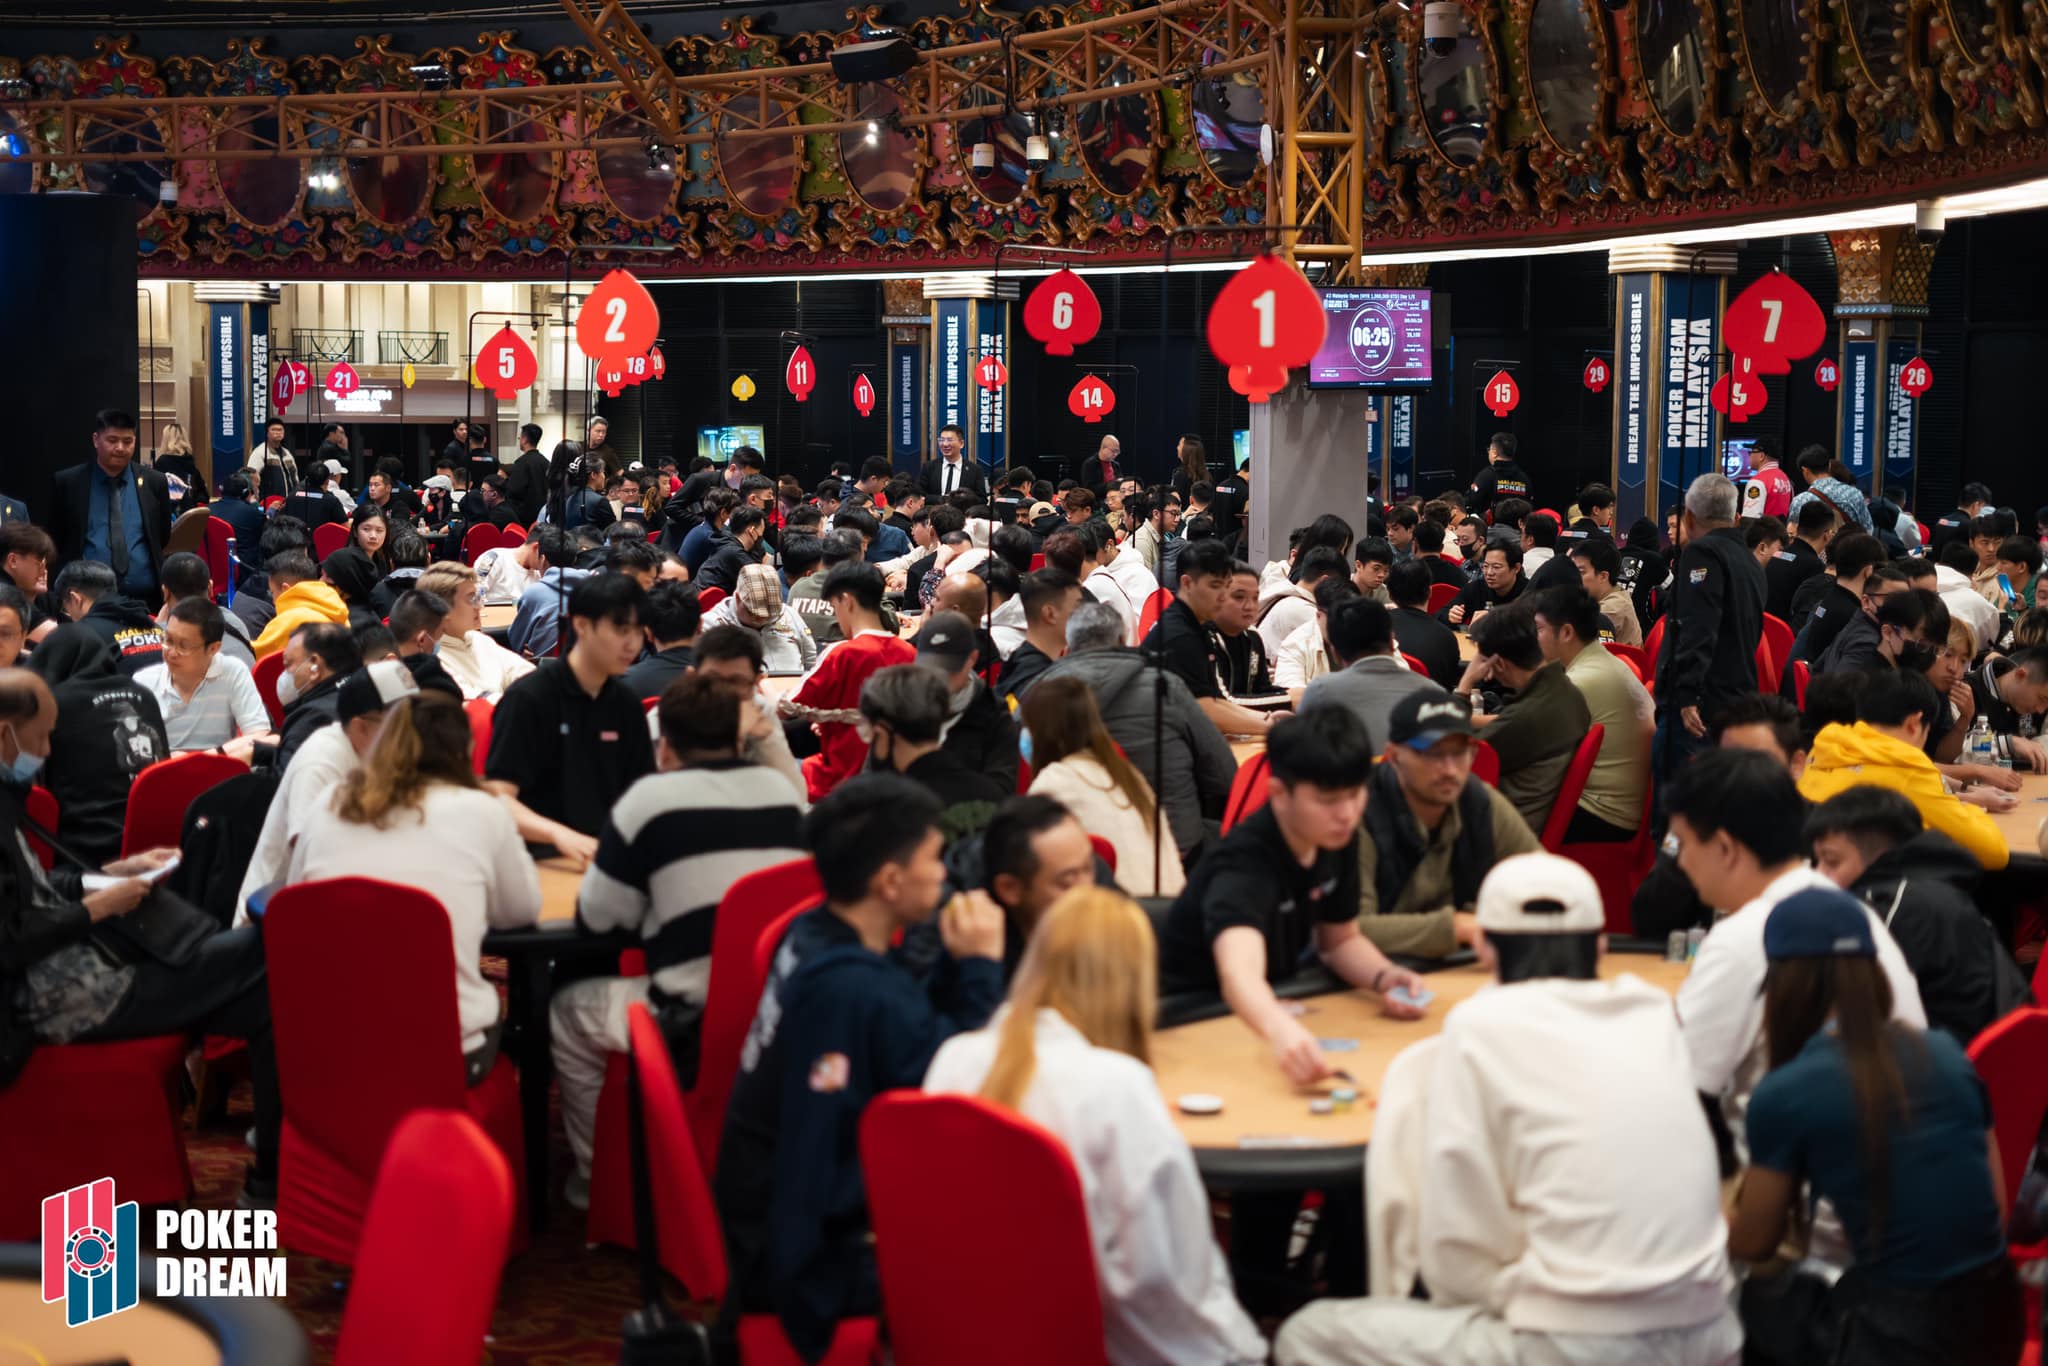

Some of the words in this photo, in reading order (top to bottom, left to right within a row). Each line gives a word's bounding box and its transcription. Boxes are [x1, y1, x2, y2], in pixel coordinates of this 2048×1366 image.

[605, 297, 627, 342] 2
[1052, 291, 1074, 330] 6
[1252, 290, 1275, 347] 1
[1761, 300, 1782, 342] 7
[220, 316, 232, 378] IMPOSSIBLE
[946, 316, 958, 384] IMPOSSIBLE
[1353, 327, 1391, 346] 06:25
[1630, 293, 1642, 381] IMPOSSIBLE
[1669, 318, 1688, 383] DREAM
[499, 347, 515, 379] 5
[626, 357, 646, 375] 18
[795, 360, 807, 385] 11
[1590, 365, 1605, 383] 29
[1820, 366, 1836, 383] 28
[1907, 367, 1926, 386] 26
[221, 379, 233, 398] THE
[278, 374, 290, 399] 12
[334, 371, 351, 389] 21
[1494, 383, 1511, 404] 15
[1685, 318, 1711, 448] MALAYSIA
[1855, 355, 1866, 412] IMPOSSIBLE
[946, 386, 959, 406] THE
[1080, 387, 1103, 409] 14
[1629, 384, 1640, 411] THE
[222, 399, 234, 436] DREAM
[1667, 389, 1684, 448] POKER
[1854, 414, 1865, 431] THE
[1627, 414, 1639, 463] DREAM
[1853, 432, 1864, 465] DREAM
[792, 598, 834, 616] WTAPS
